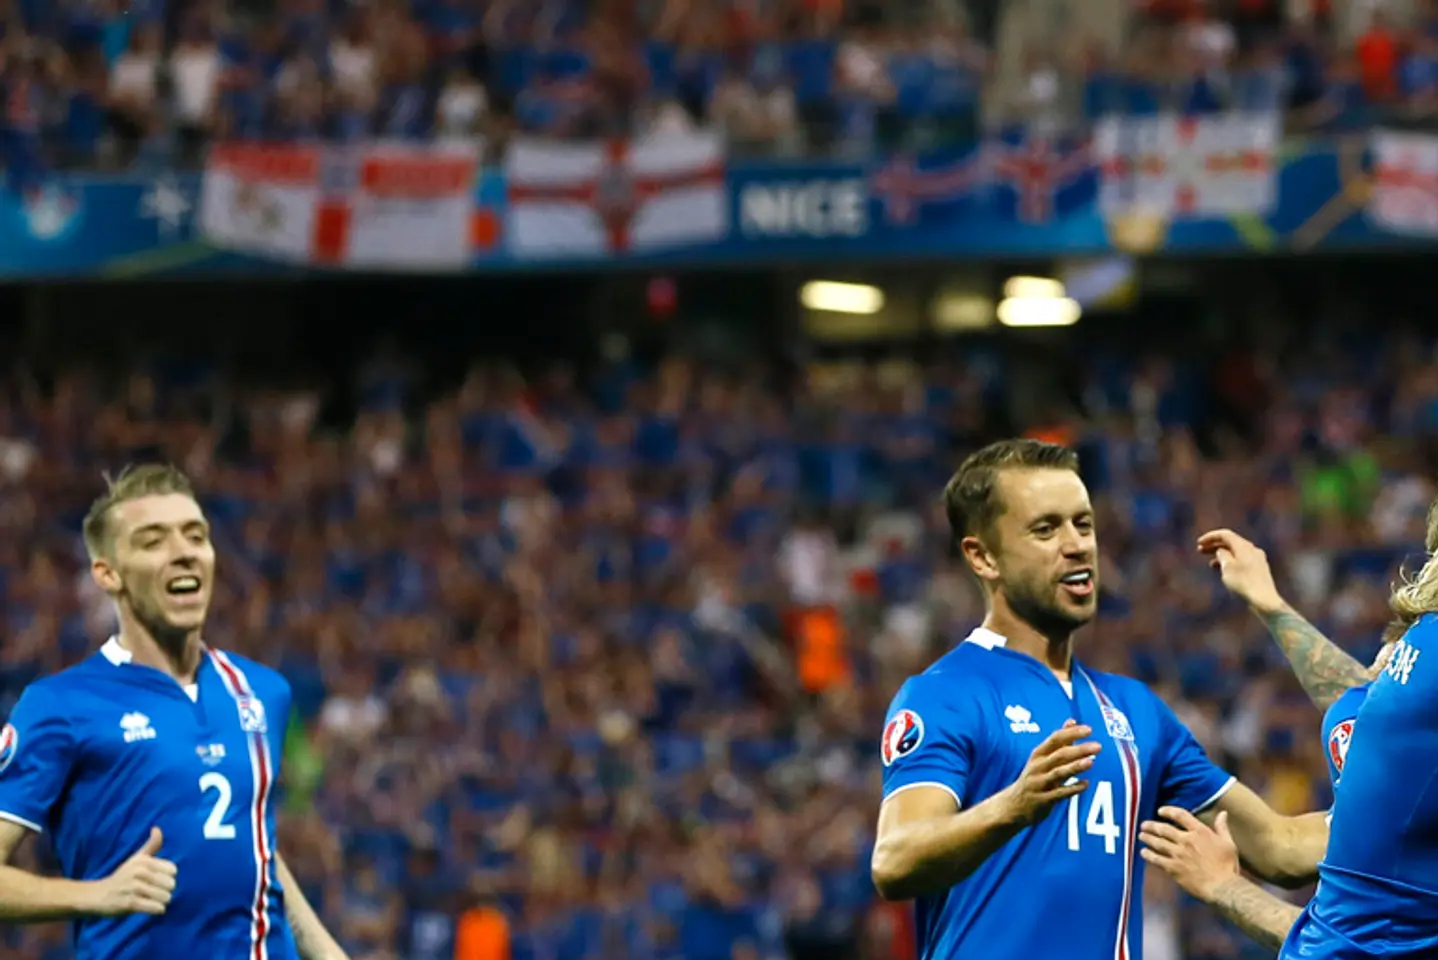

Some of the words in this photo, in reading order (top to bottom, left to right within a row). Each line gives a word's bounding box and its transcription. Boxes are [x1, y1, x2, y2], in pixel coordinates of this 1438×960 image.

[740, 181, 868, 238] NICE
[199, 771, 236, 840] 2
[1064, 776, 1120, 855] 14
